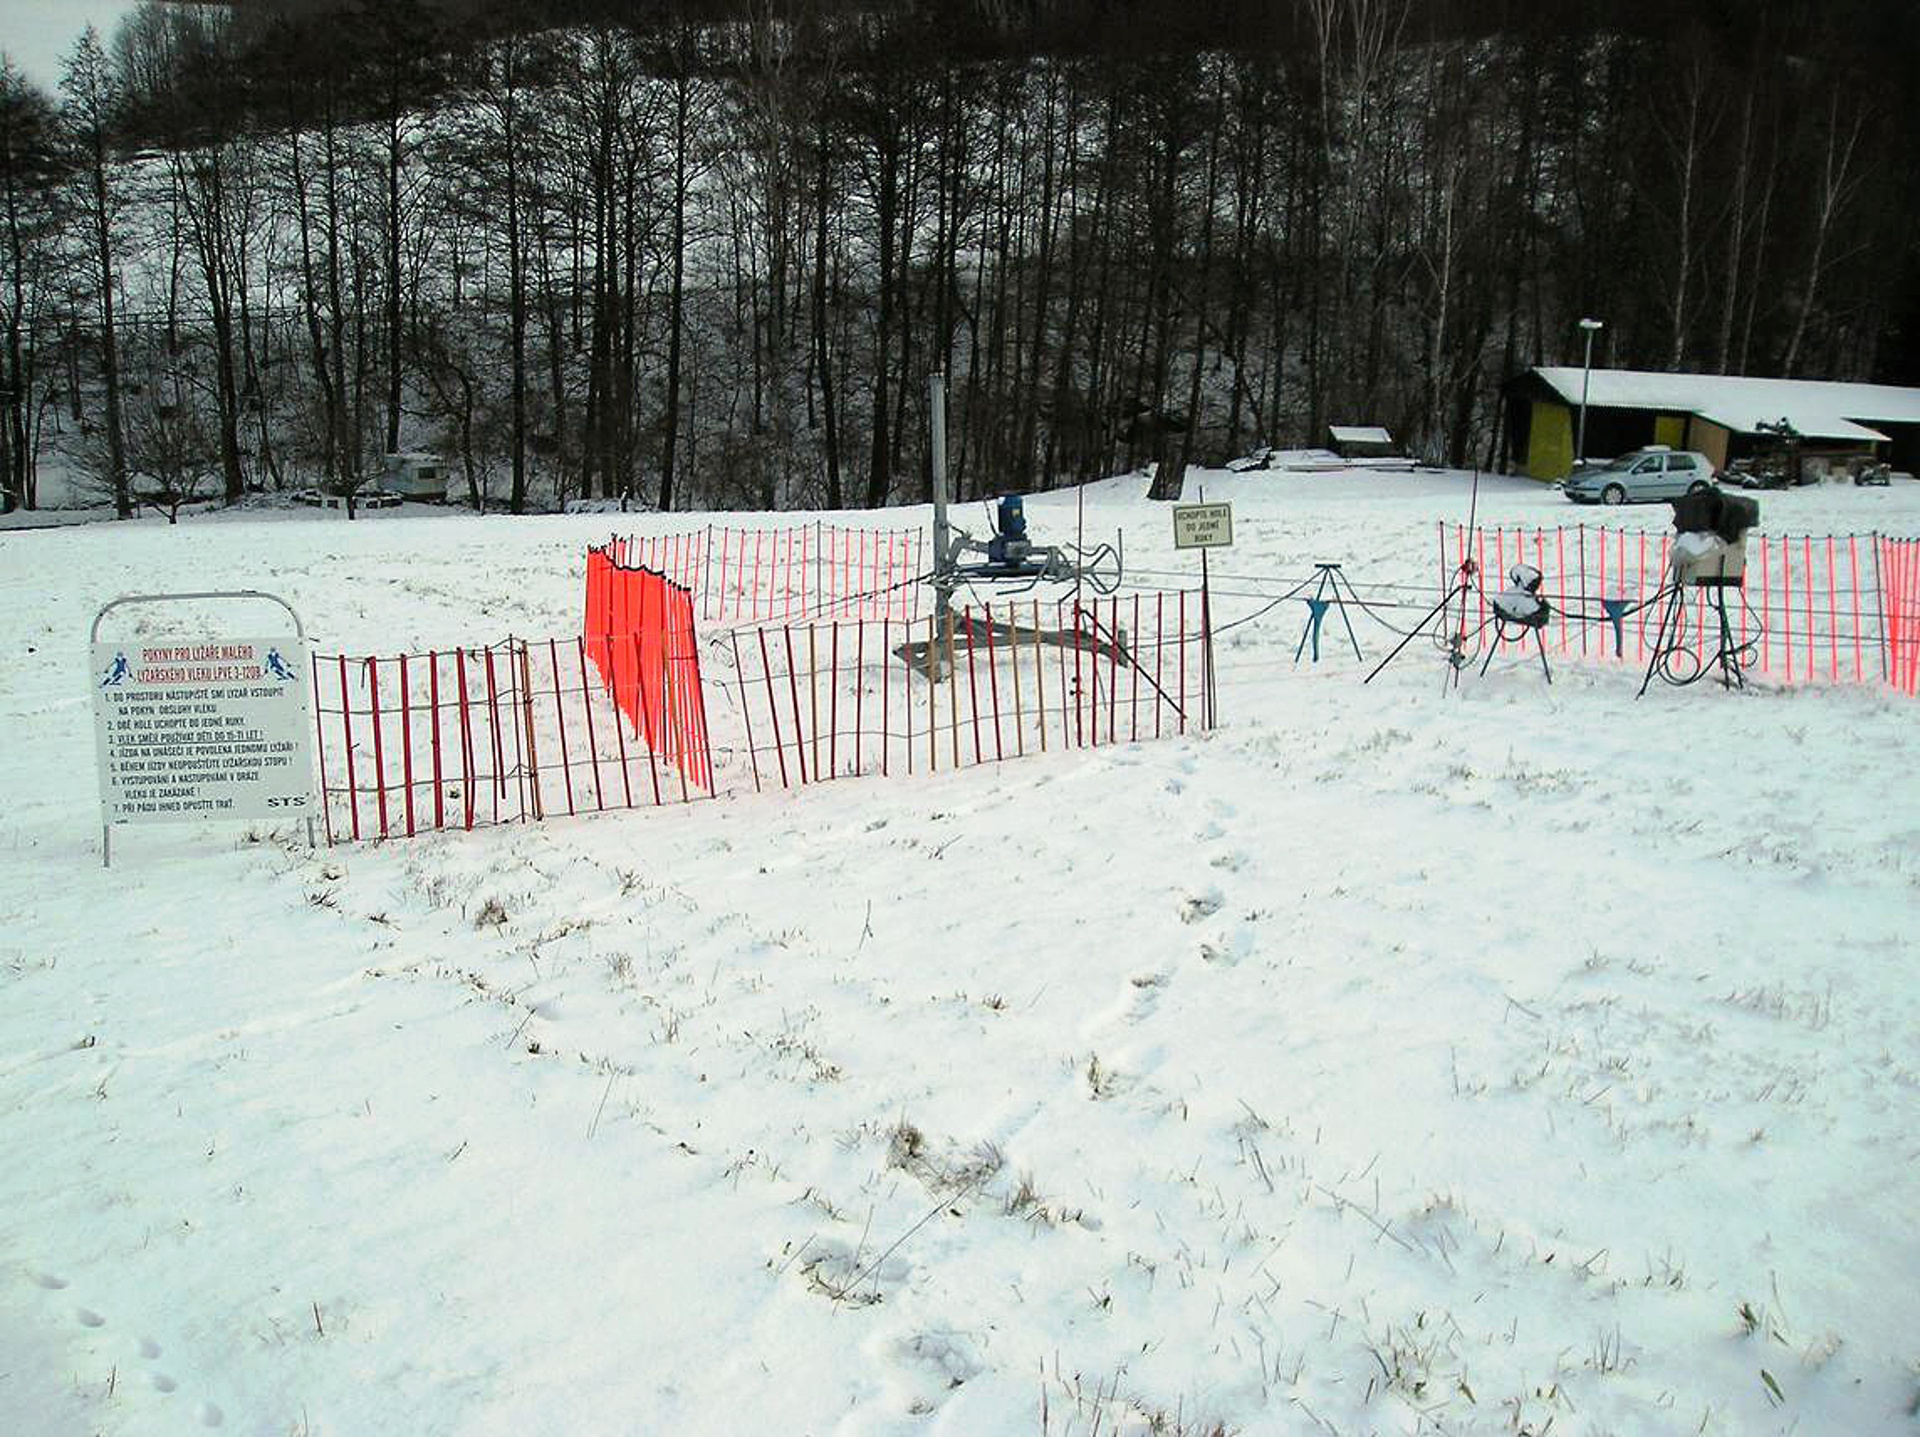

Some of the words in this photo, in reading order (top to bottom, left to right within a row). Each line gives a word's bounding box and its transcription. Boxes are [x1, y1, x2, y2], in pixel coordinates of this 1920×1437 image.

[143, 648, 172, 661] POKYNY
[174, 647, 190, 661] PRO
[118, 706, 129, 715] NA
[189, 718, 199, 728] DO
[267, 796, 306, 808] STS
